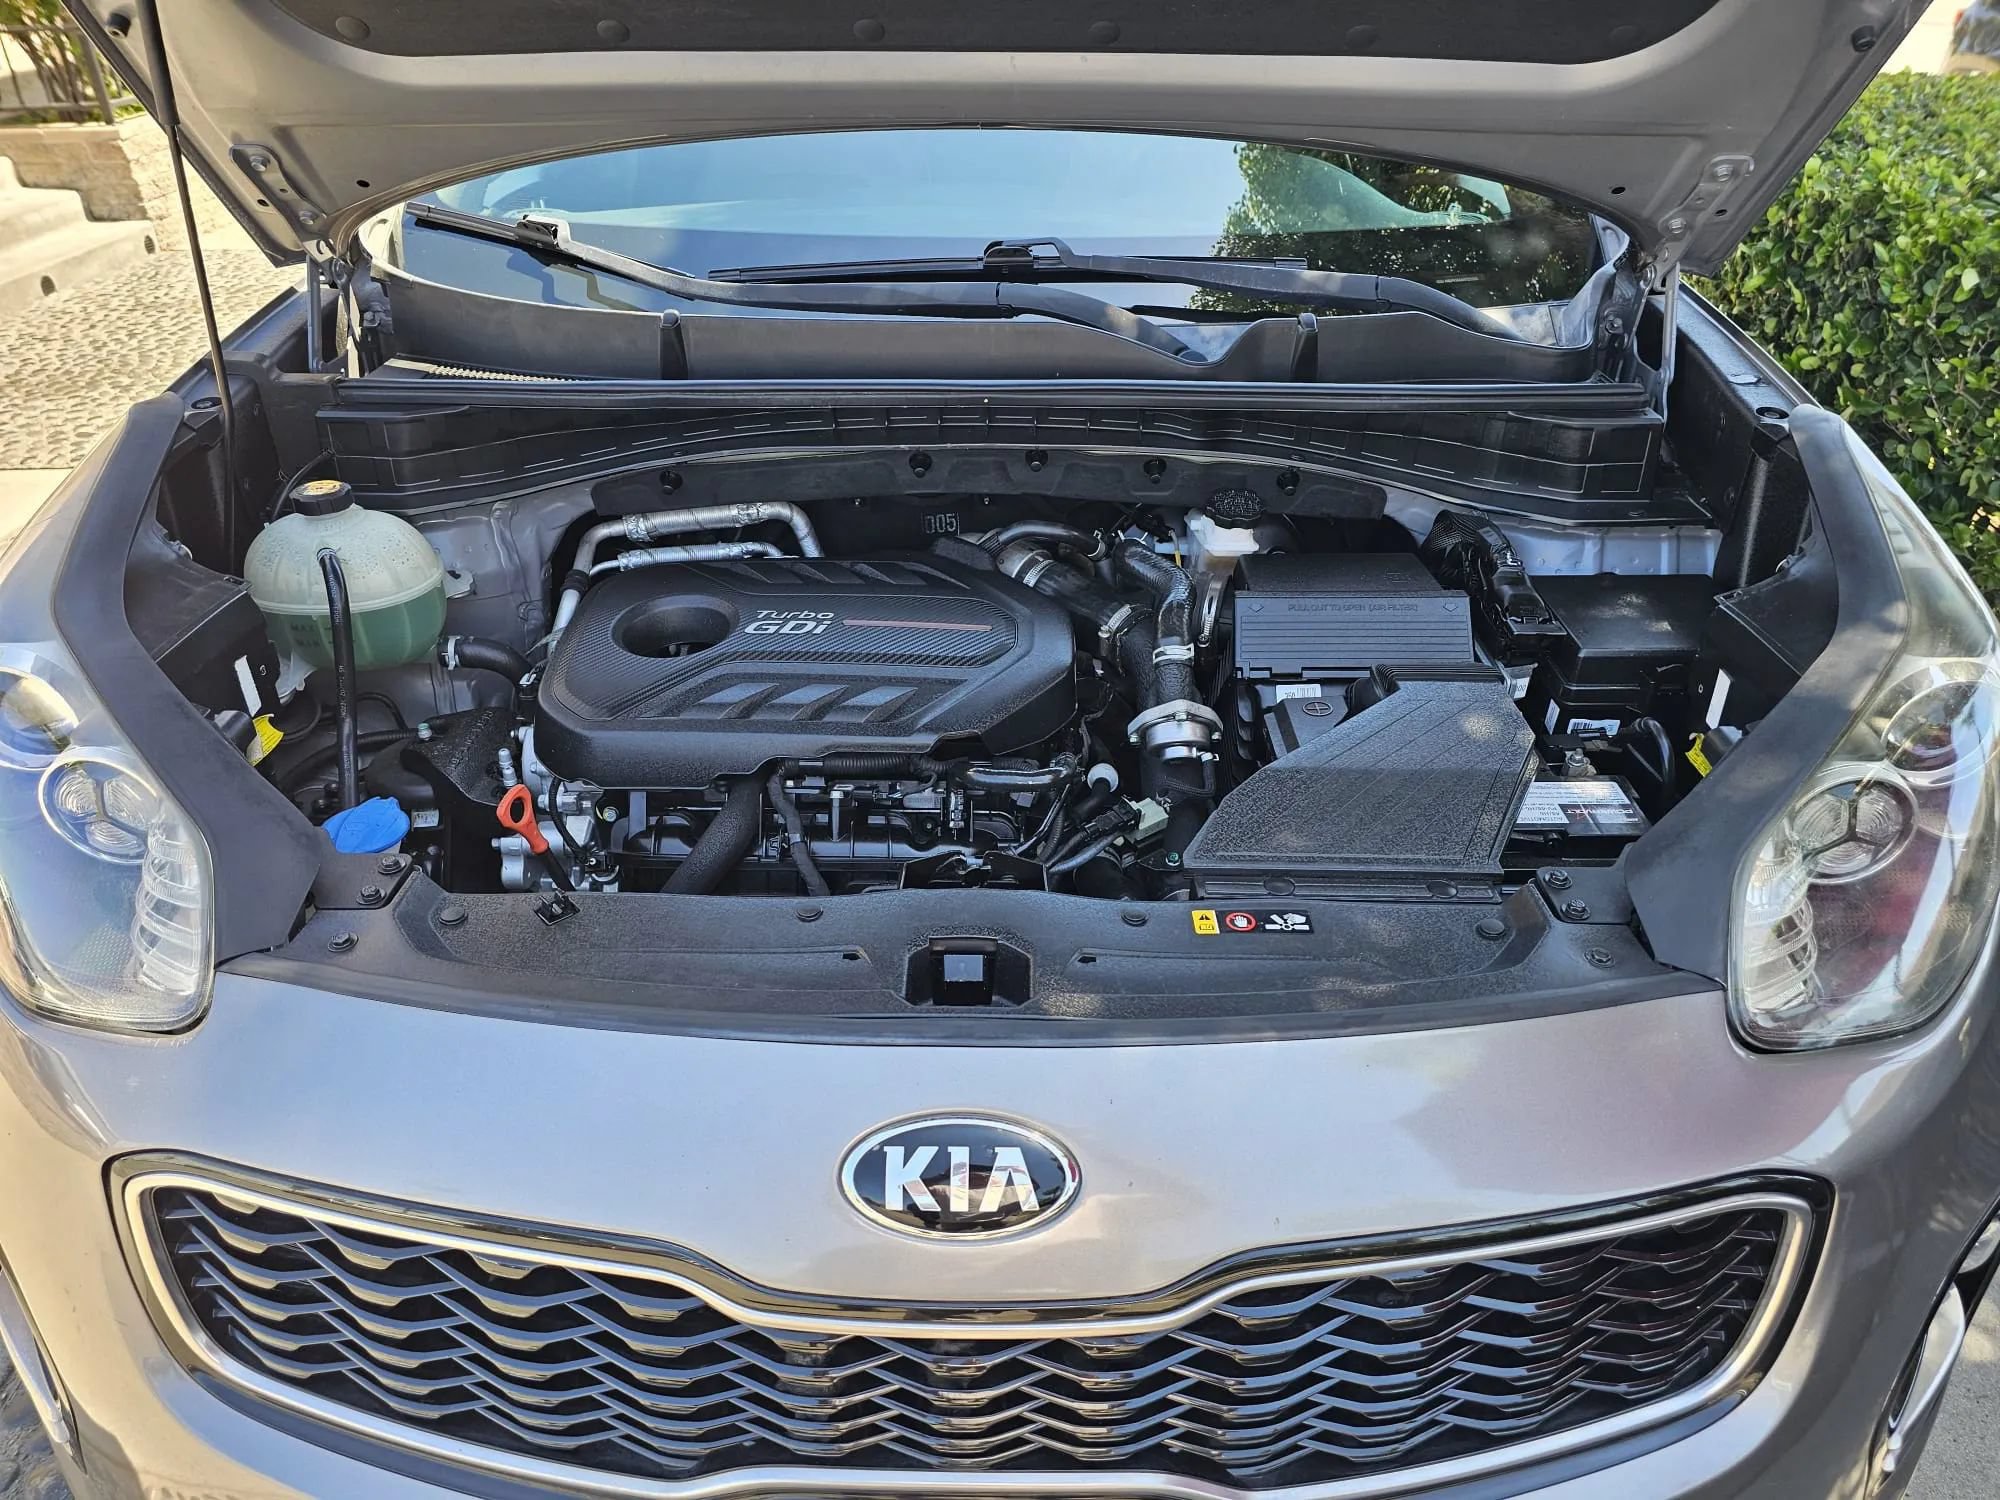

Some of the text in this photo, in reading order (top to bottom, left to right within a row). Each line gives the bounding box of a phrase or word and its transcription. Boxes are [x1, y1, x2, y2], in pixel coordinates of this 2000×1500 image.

[757, 609, 835, 619] Turbo
[744, 620, 833, 634] GDi
[884, 1145, 1040, 1213] KIA
